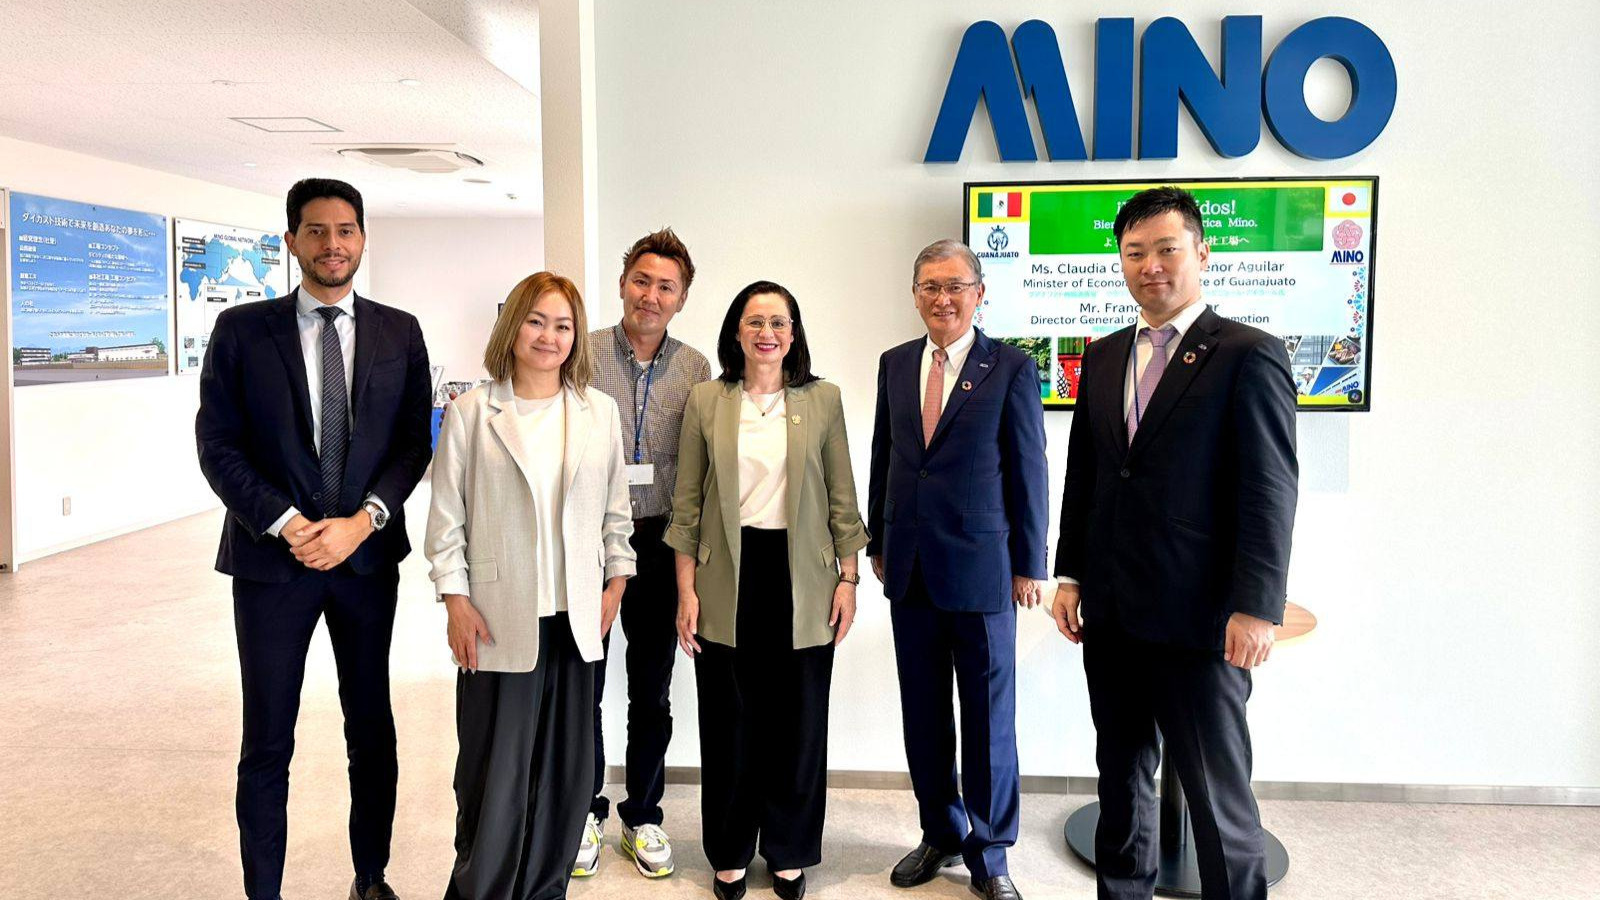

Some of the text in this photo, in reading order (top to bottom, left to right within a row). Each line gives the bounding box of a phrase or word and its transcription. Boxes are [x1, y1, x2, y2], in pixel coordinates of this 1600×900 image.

[924, 15, 1397, 162] MINO
[1202, 218, 1222, 227] rica
[1228, 217, 1258, 227] Mino.
[1331, 250, 1364, 263] MINO
[1031, 263, 1053, 274] Ms.
[1057, 263, 1107, 274] Claudia
[1111, 263, 1123, 274] C
[1237, 261, 1285, 273] Aguilar
[1023, 279, 1068, 288] Minister
[1071, 278, 1083, 288] of
[1213, 277, 1226, 287] of
[1229, 276, 1296, 287] Guanajuato
[1079, 303, 1100, 313] Mr.
[1105, 302, 1141, 313] Franc
[1030, 315, 1076, 324] Director
[1080, 315, 1124, 324] General
